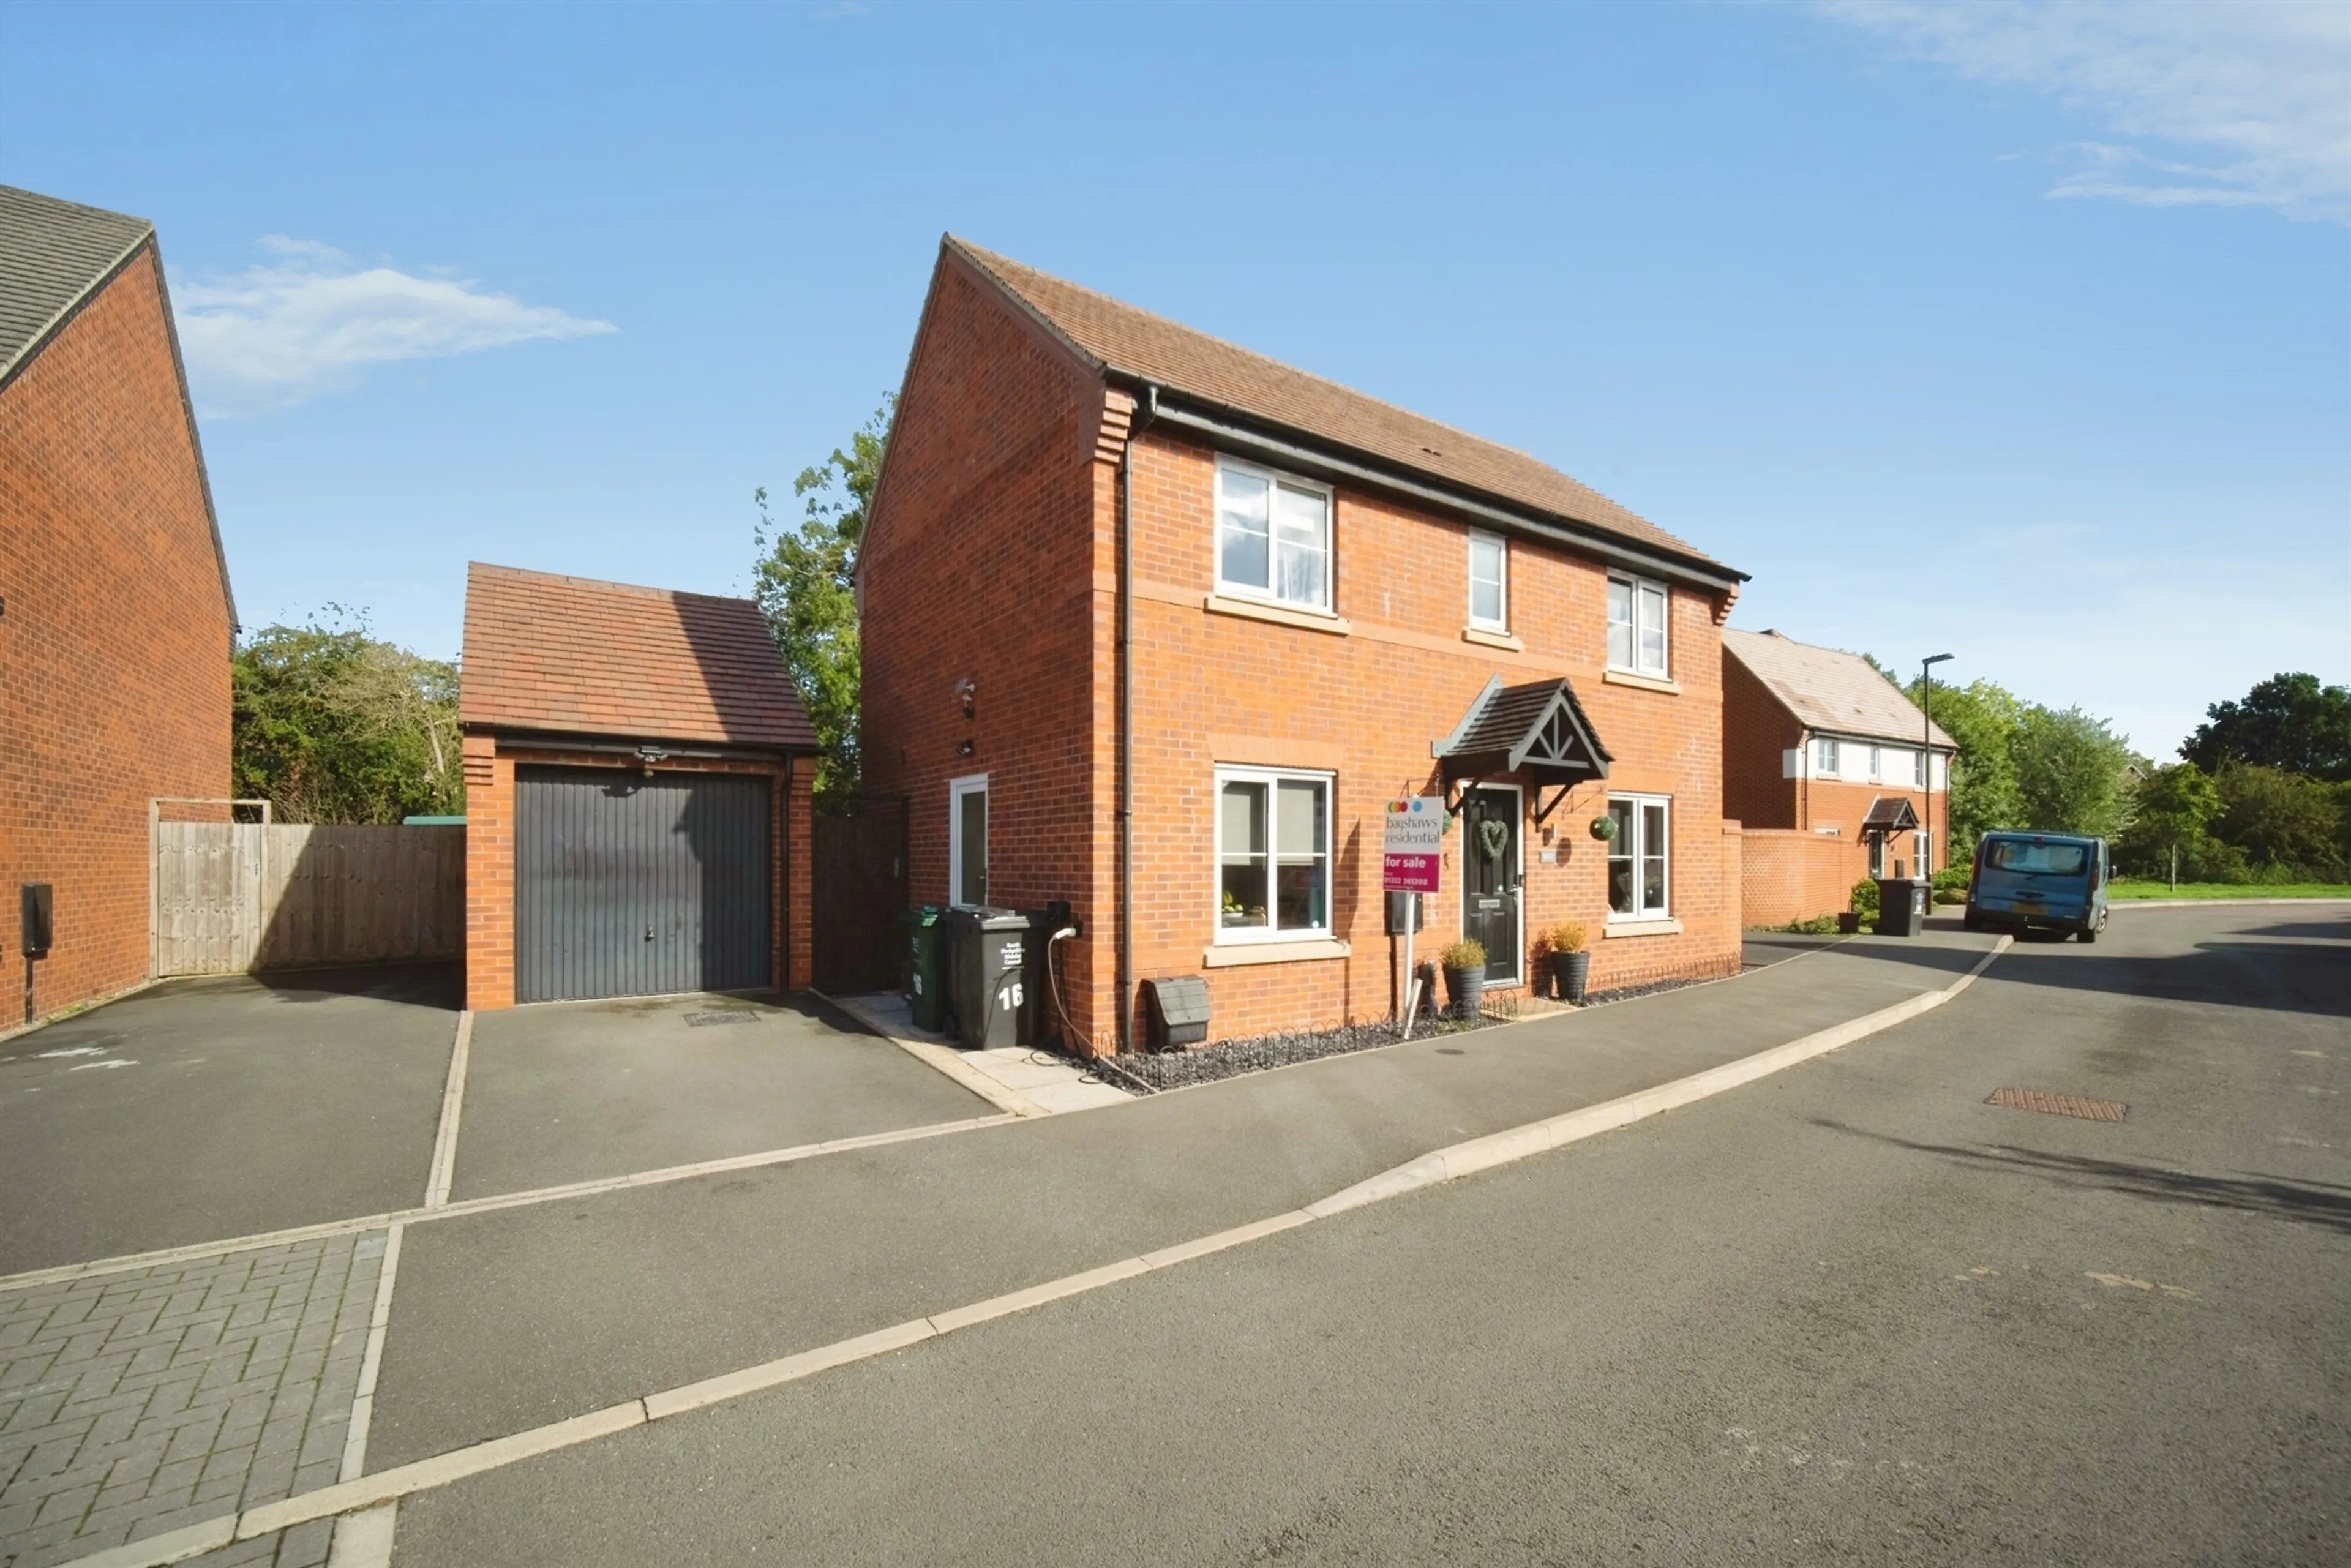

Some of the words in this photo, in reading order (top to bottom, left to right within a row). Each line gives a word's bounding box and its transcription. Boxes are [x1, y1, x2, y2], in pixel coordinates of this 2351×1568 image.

[1386, 816, 1438, 831] bagshaws
[1385, 830, 1439, 844] residential
[1385, 856, 1401, 867] for
[1403, 857, 1426, 868] sale
[999, 982, 1024, 1010] 16
